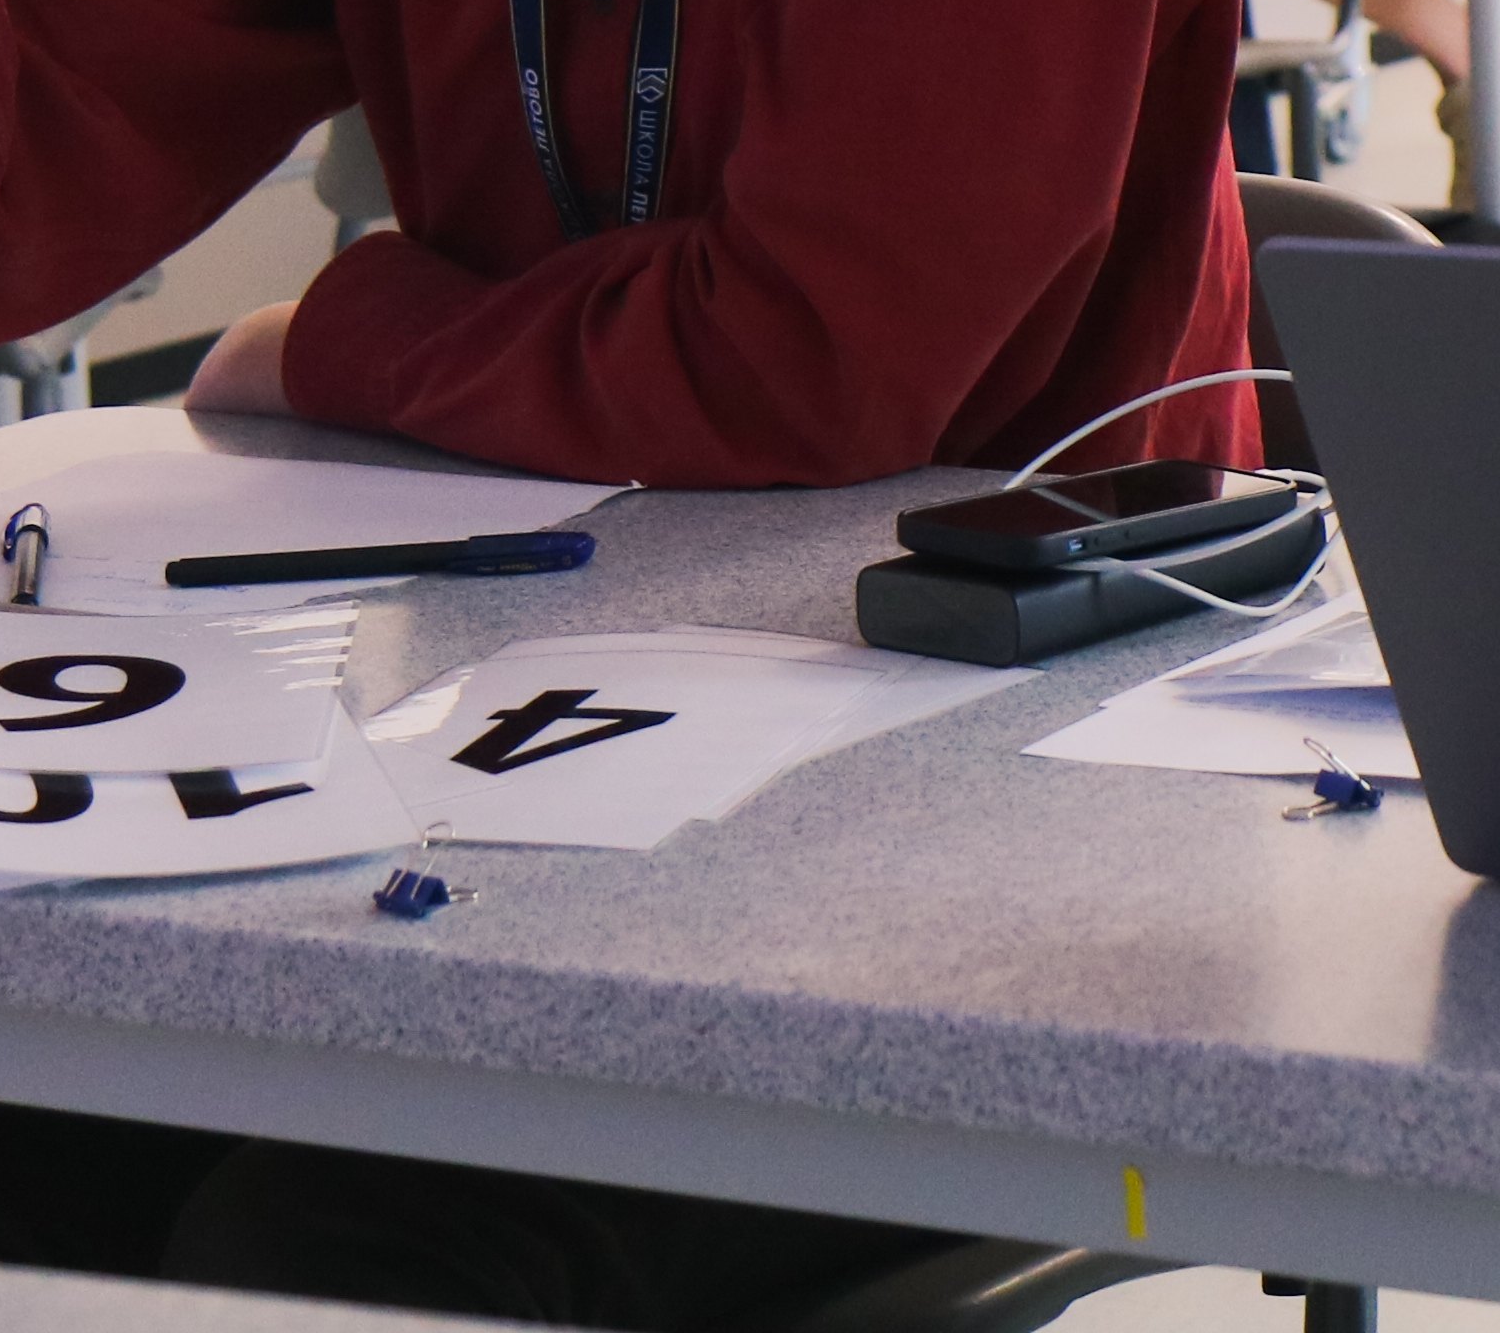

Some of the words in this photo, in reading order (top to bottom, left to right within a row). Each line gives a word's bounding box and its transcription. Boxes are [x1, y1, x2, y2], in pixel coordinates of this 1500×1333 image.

[525, 67, 551, 152] ЛЕТОВО
[634, 110, 658, 185] ШКОЛА
[449, 689, 678, 775] 4
